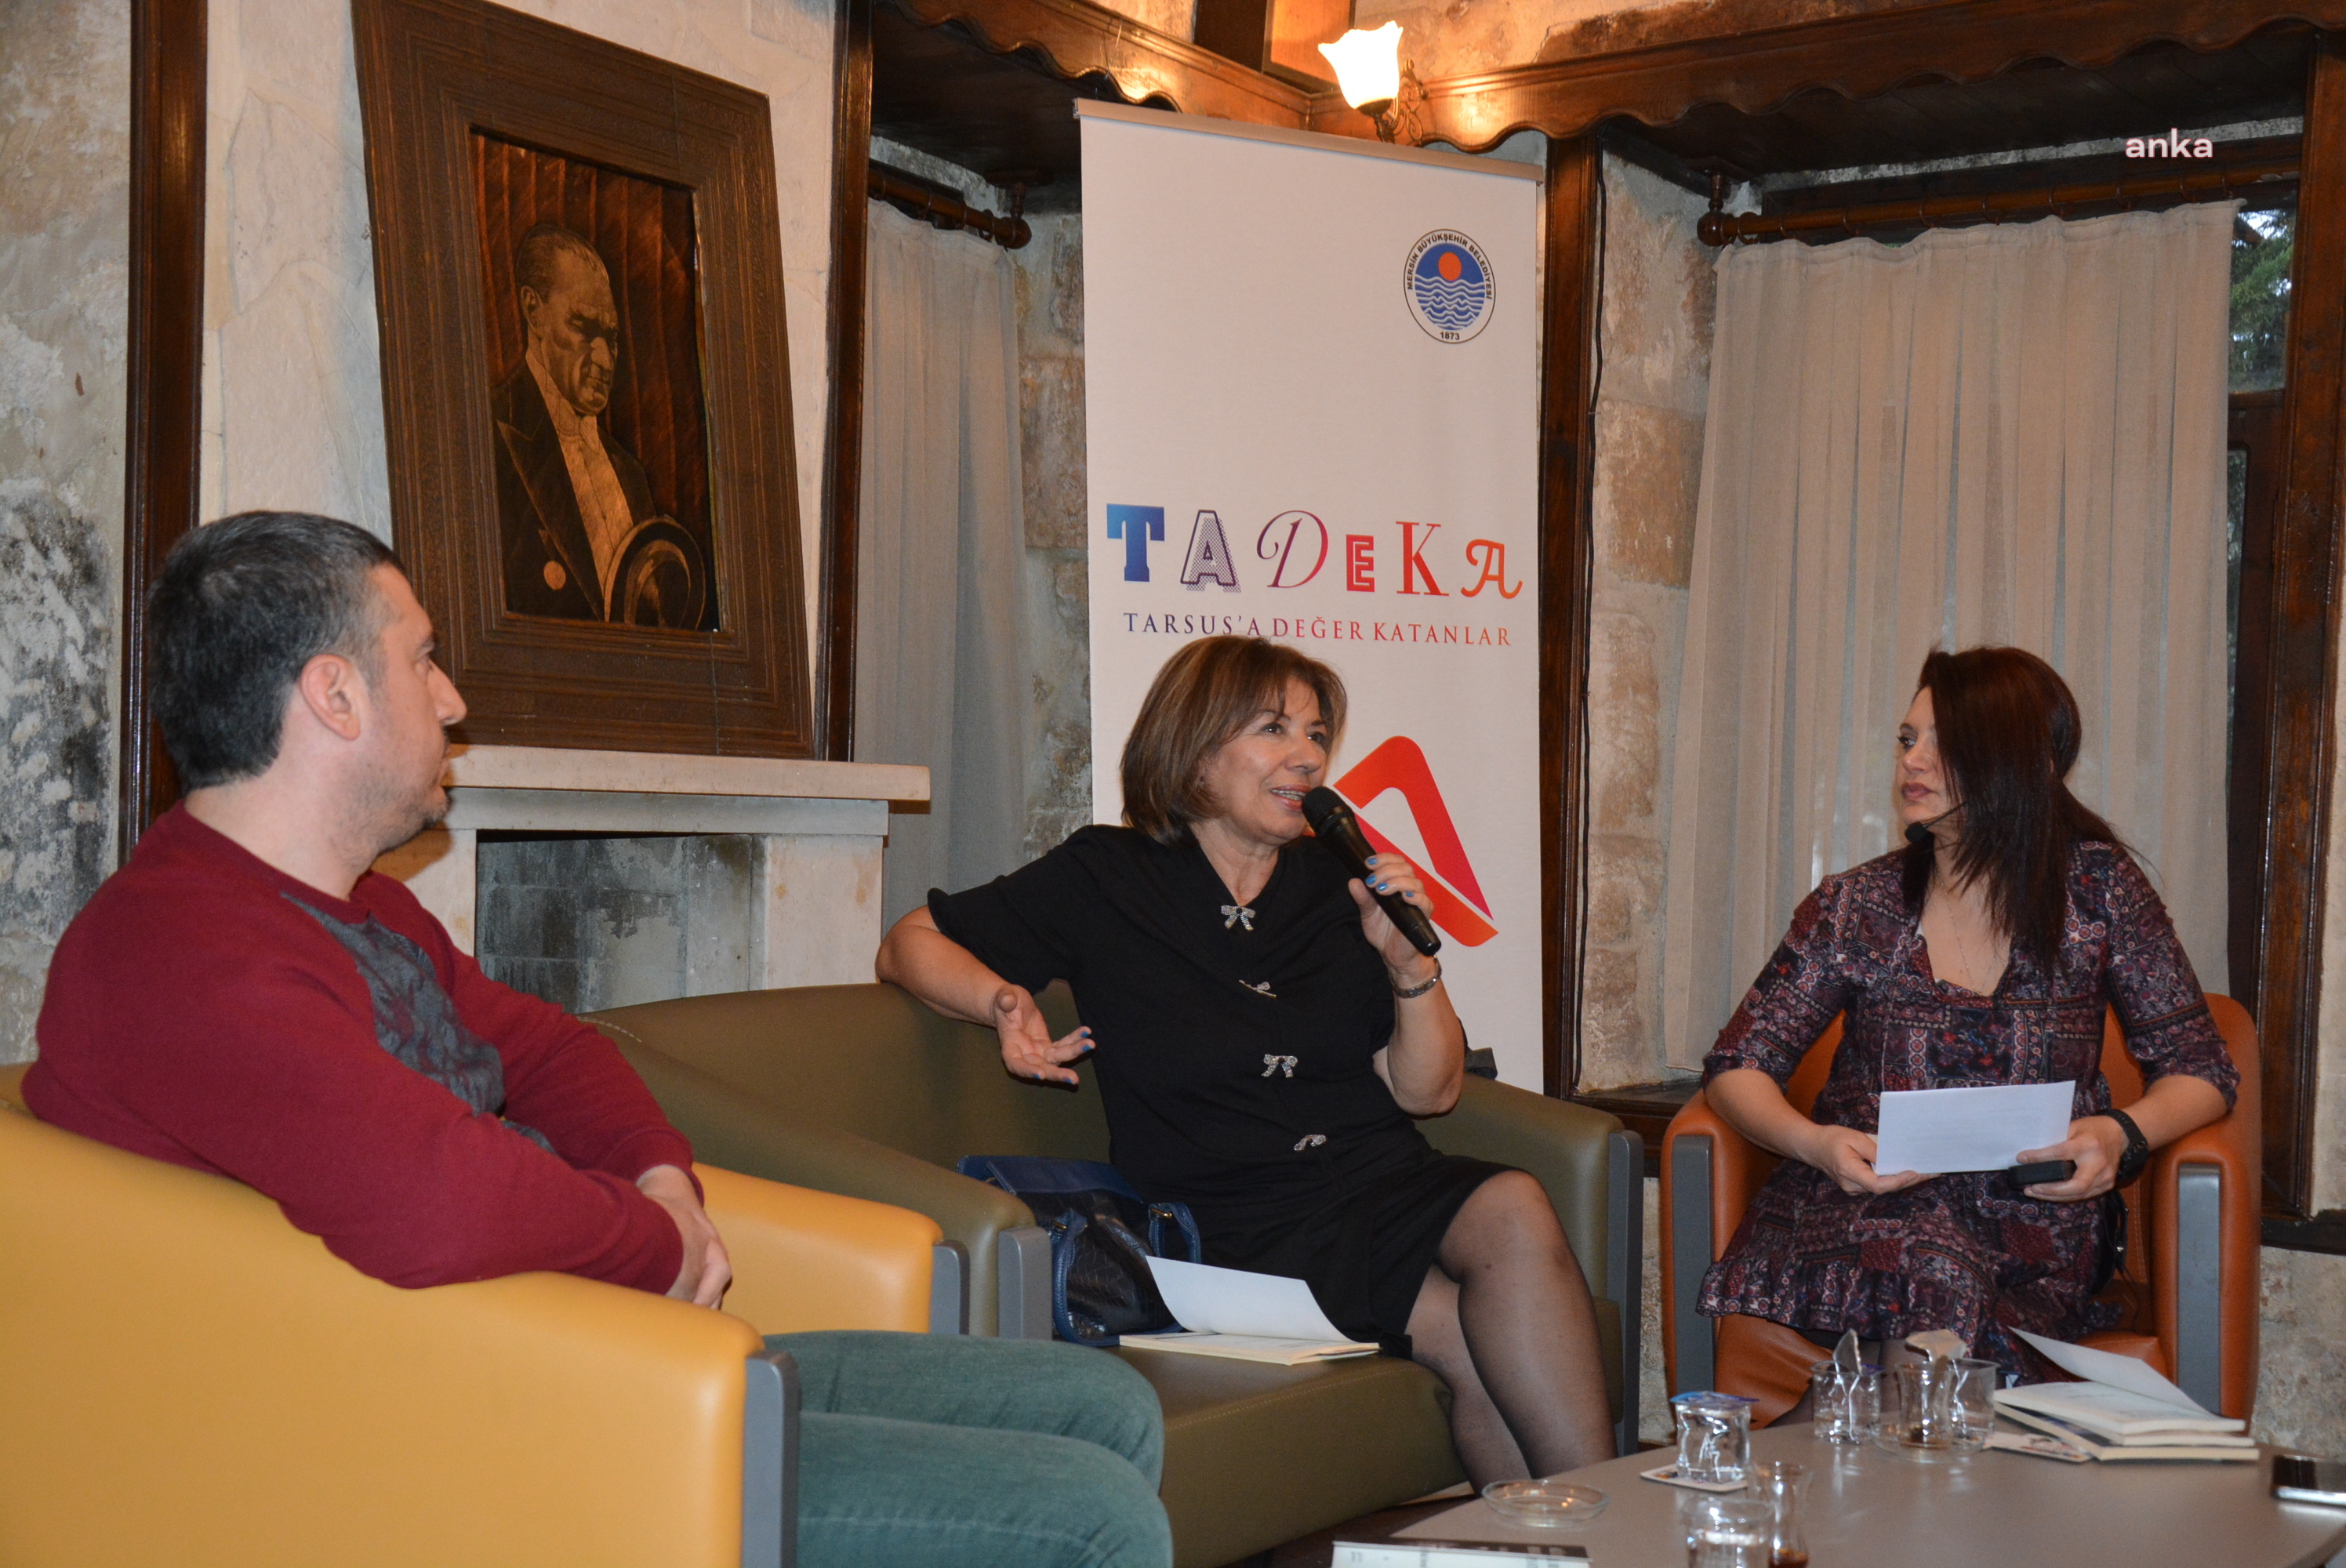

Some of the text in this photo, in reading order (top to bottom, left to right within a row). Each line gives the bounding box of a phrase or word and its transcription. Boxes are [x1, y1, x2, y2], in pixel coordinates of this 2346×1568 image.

[1407, 233, 1493, 299] MERSİN BÜYÜKŞEHİR BELEDİYESİ
[1440, 331, 1460, 340] 1873
[1106, 503, 1523, 600] TADEKA
[1123, 612, 1511, 646] TARSUS'A DEĞER KATANLAR
